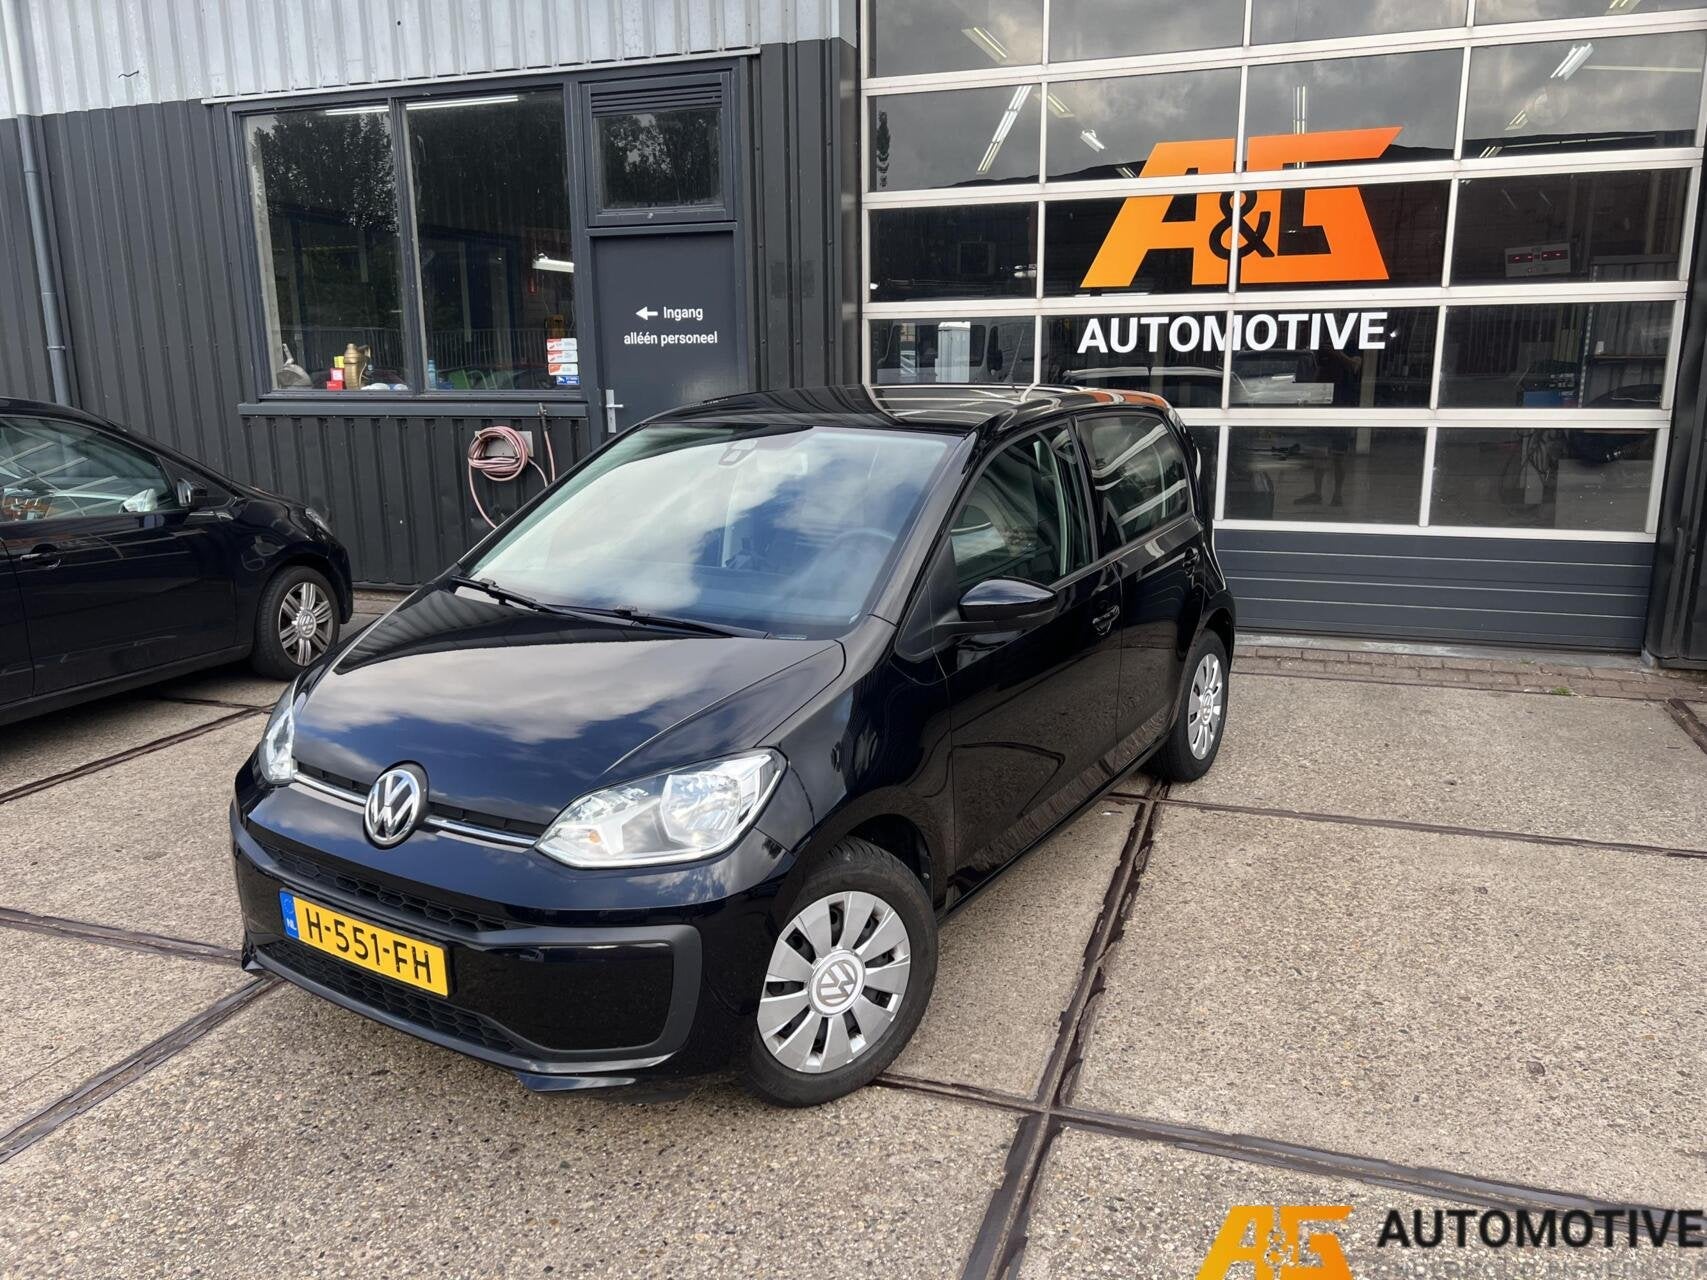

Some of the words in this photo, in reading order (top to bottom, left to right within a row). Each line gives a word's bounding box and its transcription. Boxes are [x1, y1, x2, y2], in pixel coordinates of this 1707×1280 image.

[1080, 126, 1403, 288] A&G
[663, 306, 704, 321] Ingang
[623, 331, 658, 345] alléén
[660, 330, 718, 347] personeel
[1076, 311, 1389, 354] AUTOMOTIVE
[286, 918, 298, 931] NL
[305, 907, 432, 984] H-551-FH
